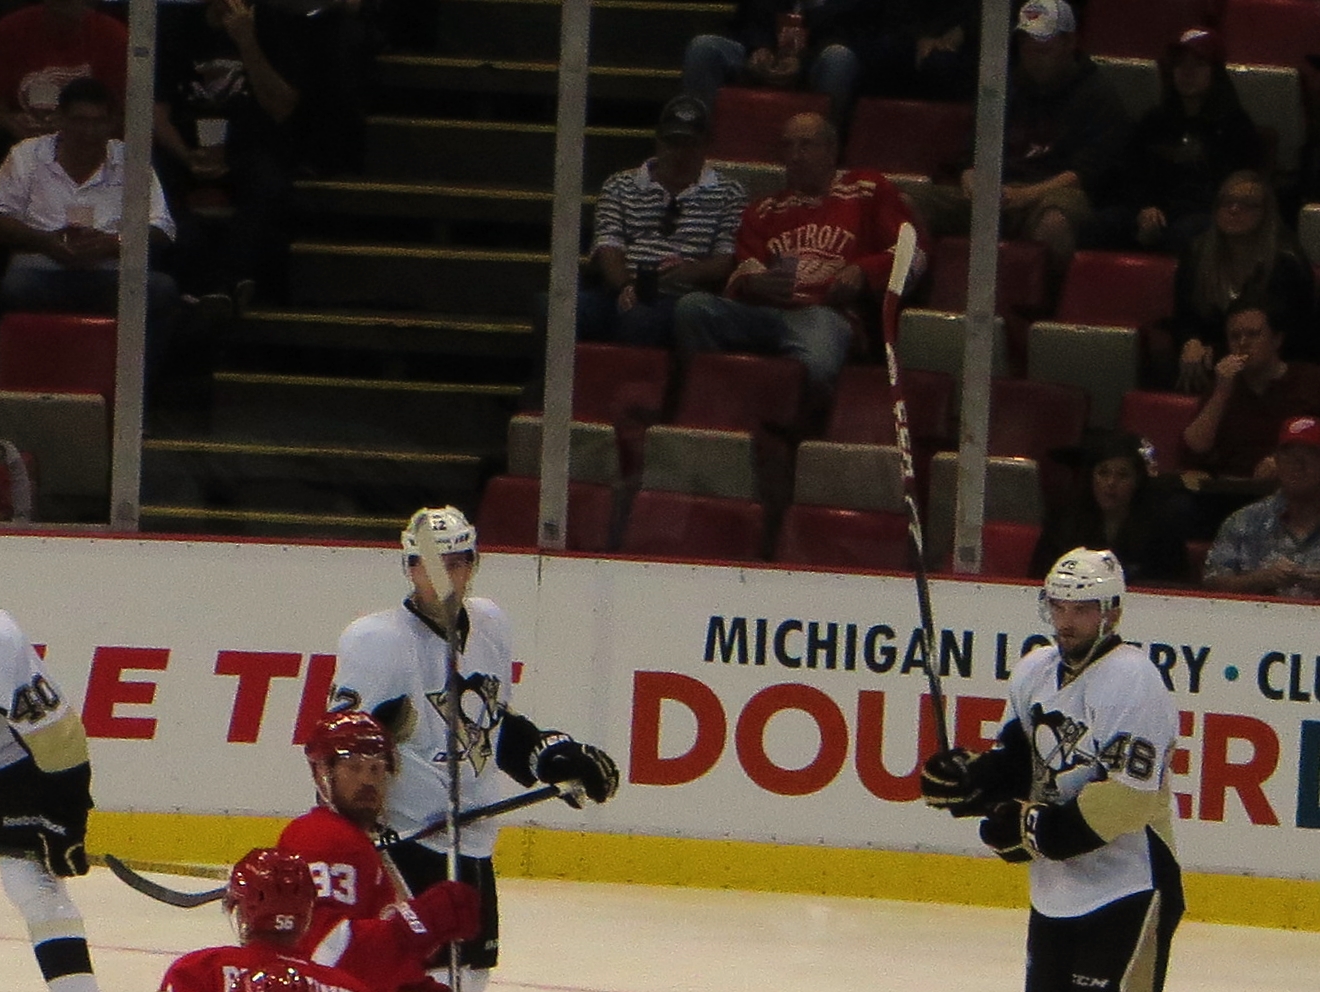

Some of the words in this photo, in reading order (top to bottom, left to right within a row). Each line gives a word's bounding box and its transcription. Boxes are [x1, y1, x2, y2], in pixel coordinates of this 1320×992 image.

[767, 223, 855, 255] DETROIT
[704, 615, 975, 679] MICHIGAN
[1257, 651, 1320, 702] CL
[10, 672, 60, 724] 40
[275, 915, 295, 930] 56
